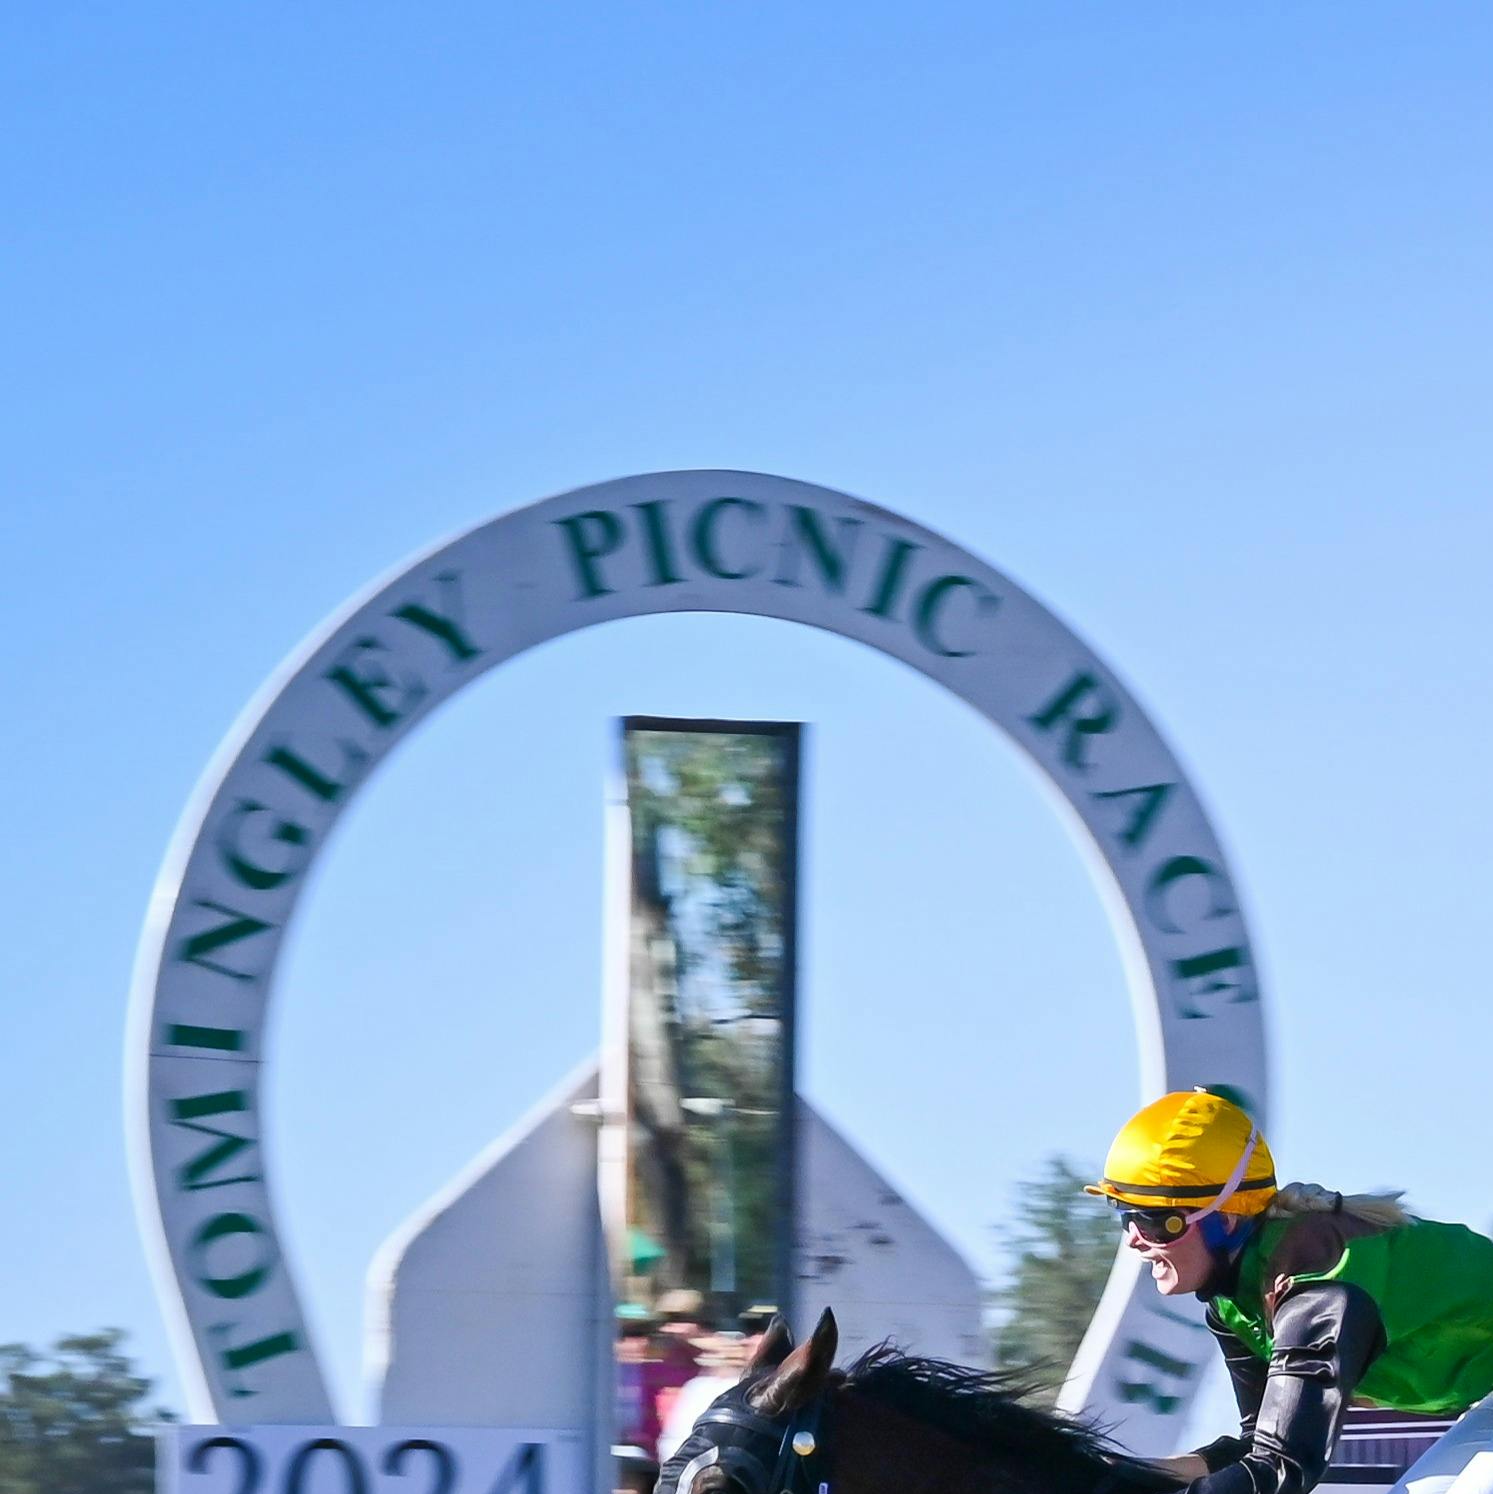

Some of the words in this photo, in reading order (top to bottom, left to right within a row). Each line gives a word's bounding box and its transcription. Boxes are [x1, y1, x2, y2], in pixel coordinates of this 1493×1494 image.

[166, 568, 484, 1398] TOMINGLEY
[551, 496, 1003, 657] PICNIC
[1024, 671, 1260, 1019] RACE
